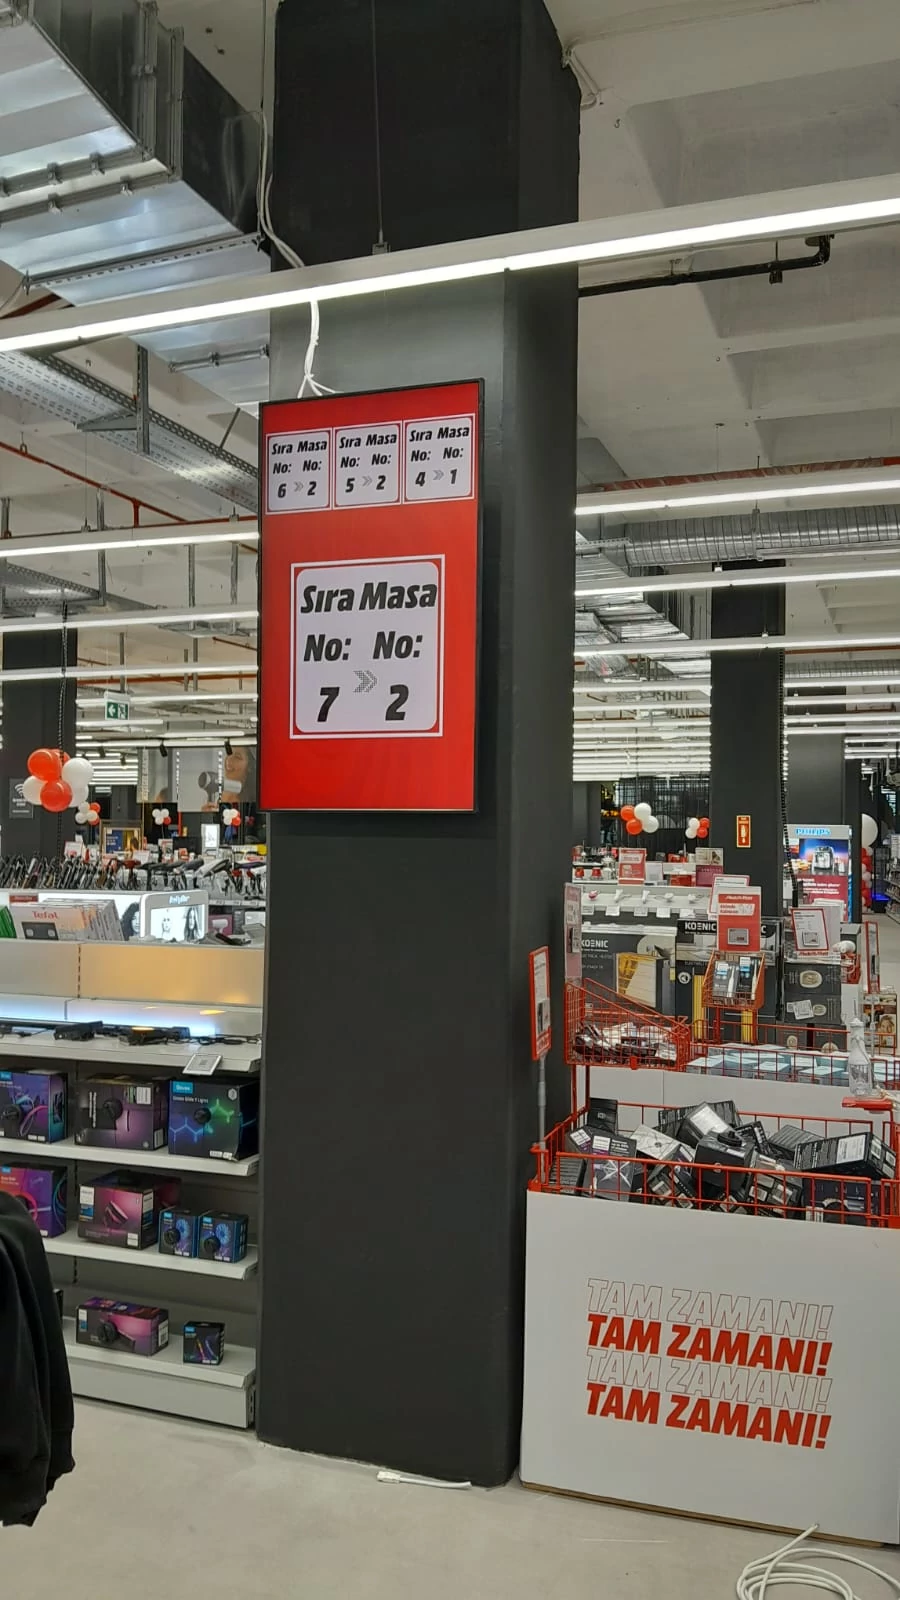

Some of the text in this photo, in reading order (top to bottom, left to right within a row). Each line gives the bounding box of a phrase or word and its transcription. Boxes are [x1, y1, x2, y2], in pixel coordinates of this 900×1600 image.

[339, 432, 397, 449] Sıra Masa
[409, 425, 470, 442] Sıra Masa
[272, 439, 327, 455] Sıra Masa
[410, 446, 464, 462] No: No:
[273, 460, 322, 474] No: No:
[340, 453, 392, 468] No: No:
[345, 475, 386, 493] 5 2
[415, 469, 458, 487] 4 1
[277, 481, 317, 498] 6 2
[300, 581, 438, 613] Sıra Masa
[303, 631, 423, 662] No: No:
[317, 684, 409, 722] 7 2
[32, 910, 58, 920] Tefal
[685, 922, 717, 931] KOENIC
[587, 1279, 833, 1340] TAM ZAMANI!
[587, 1314, 832, 1376] TAM ZAMANI!
[586, 1348, 832, 1413] TAM ZAMANI!
[586, 1383, 831, 1449] TAM ZAMANI!
